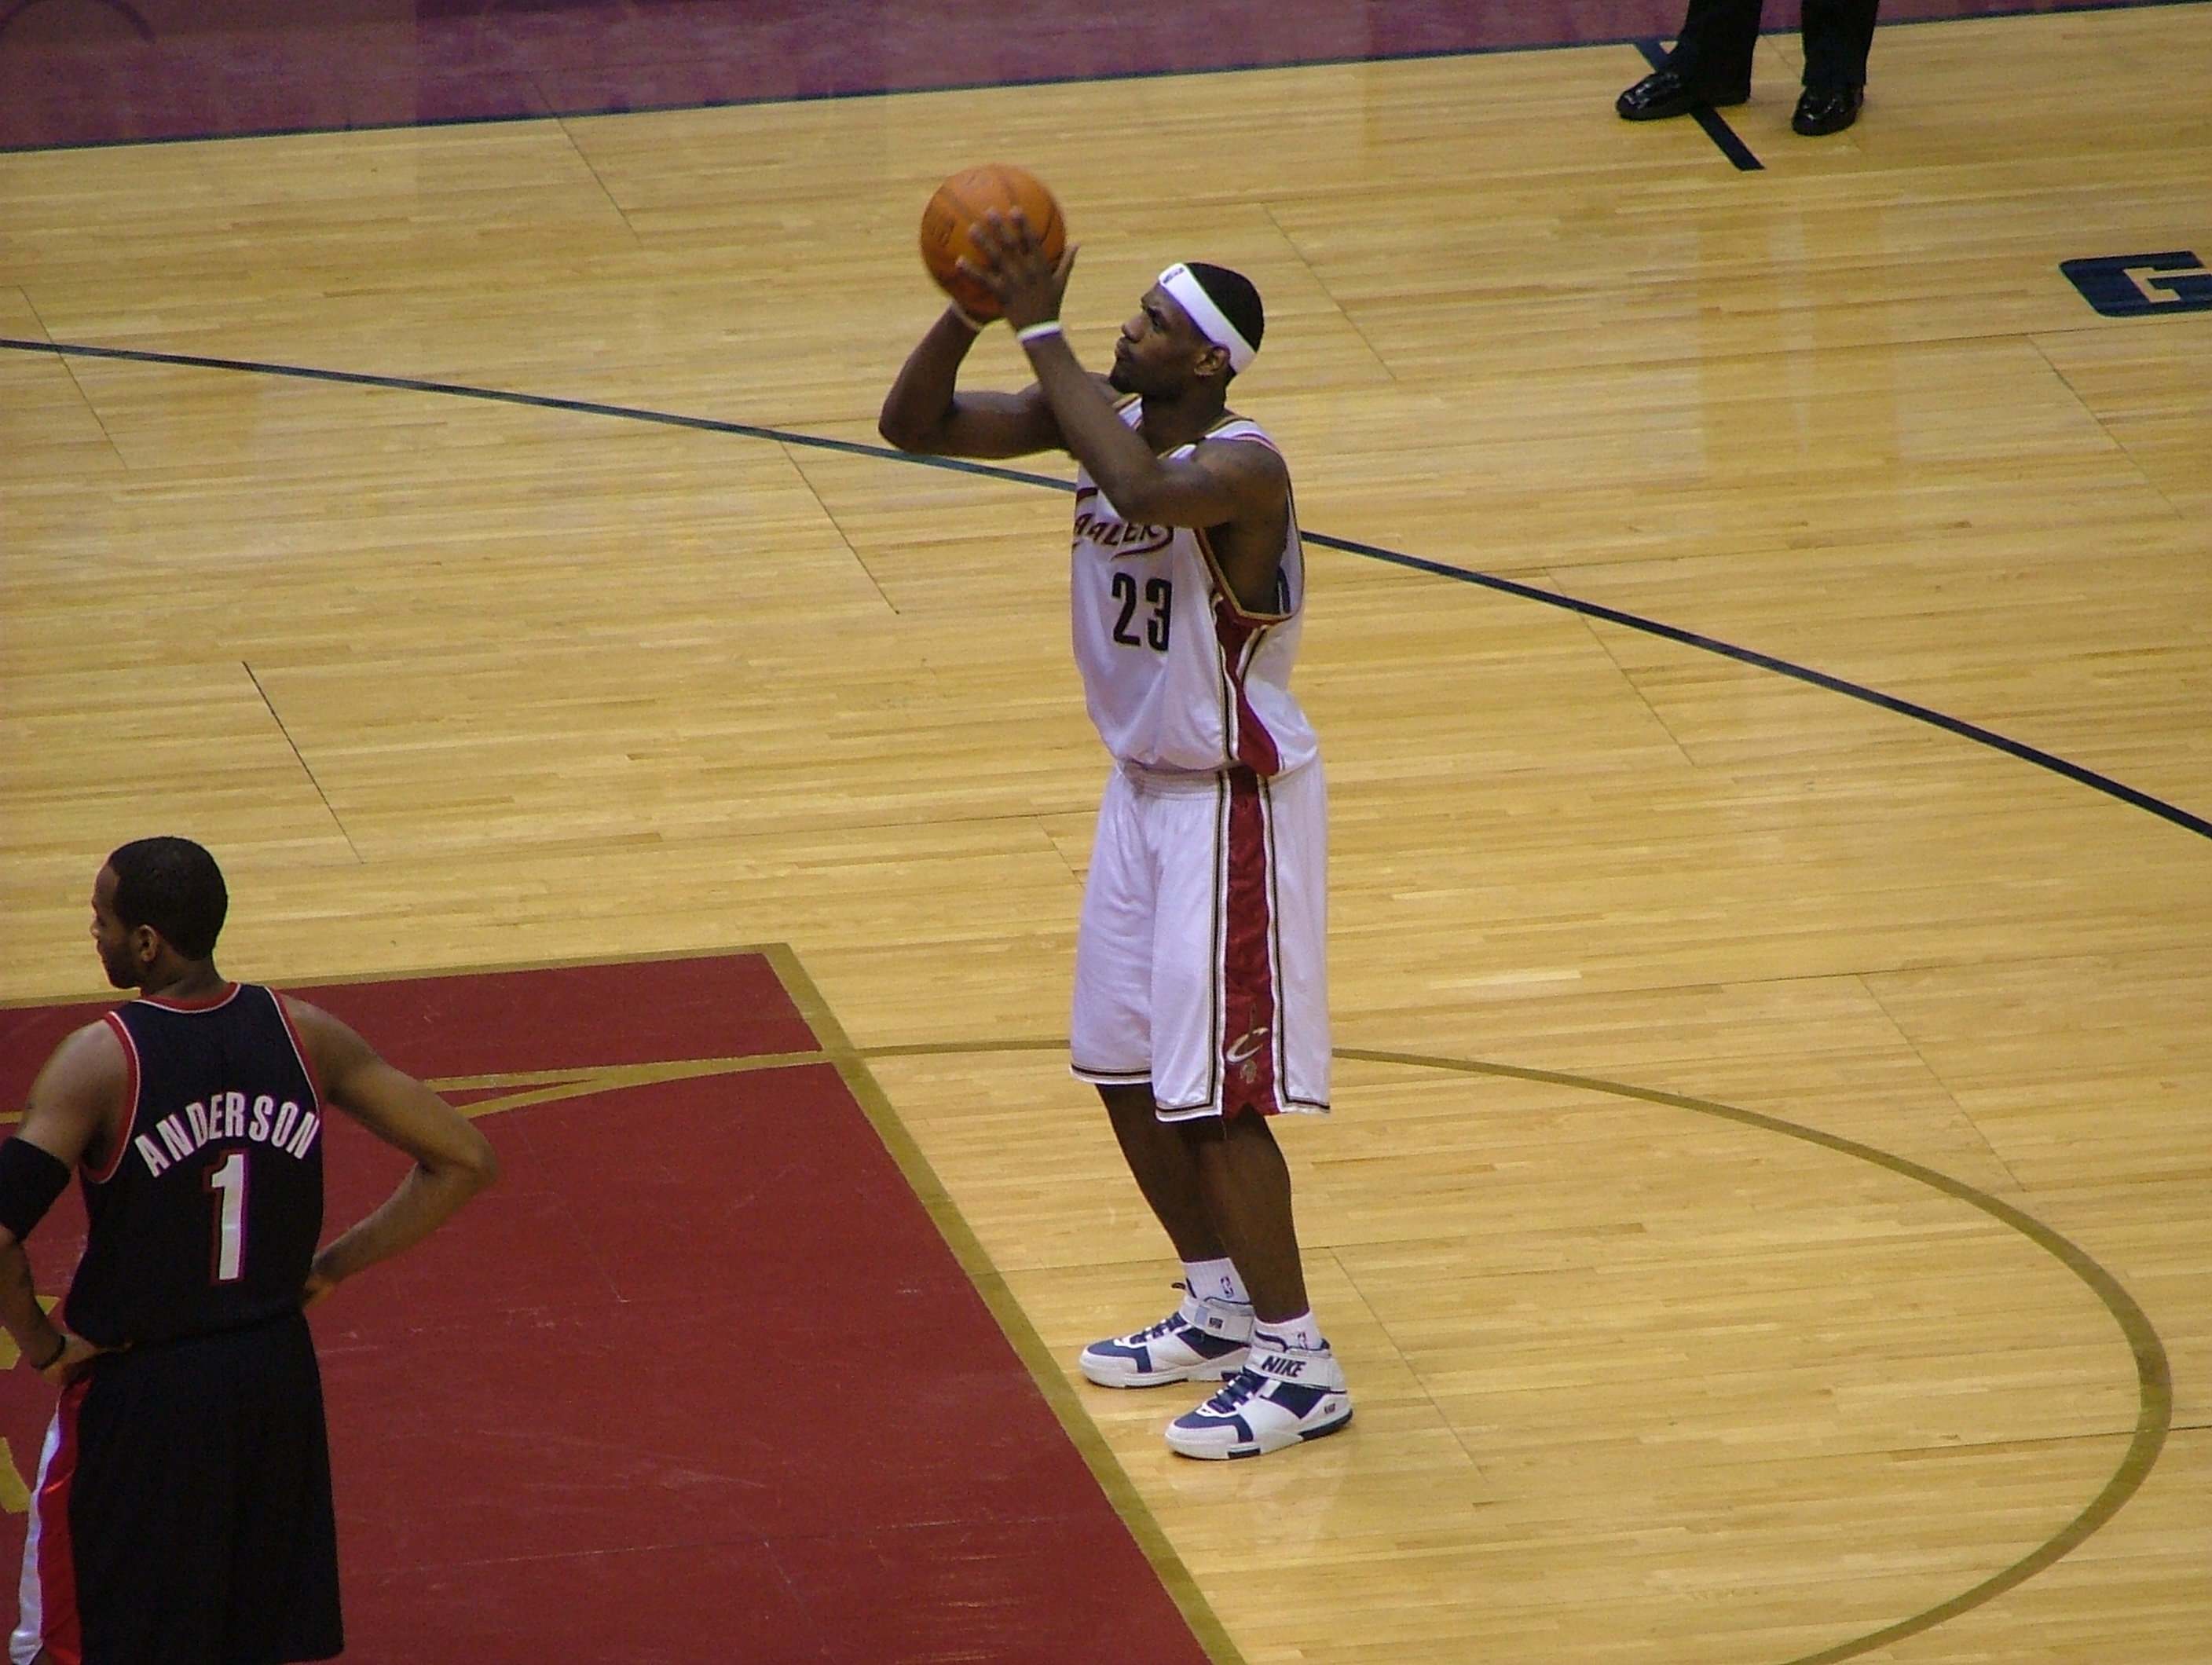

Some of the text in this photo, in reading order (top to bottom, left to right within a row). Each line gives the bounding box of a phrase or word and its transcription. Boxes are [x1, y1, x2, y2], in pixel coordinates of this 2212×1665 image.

[1111, 571, 1172, 652] 23
[134, 1091, 320, 1178] ANDERSON
[209, 1152, 246, 1282] 1
[1262, 1356, 1306, 1378] NIKE
